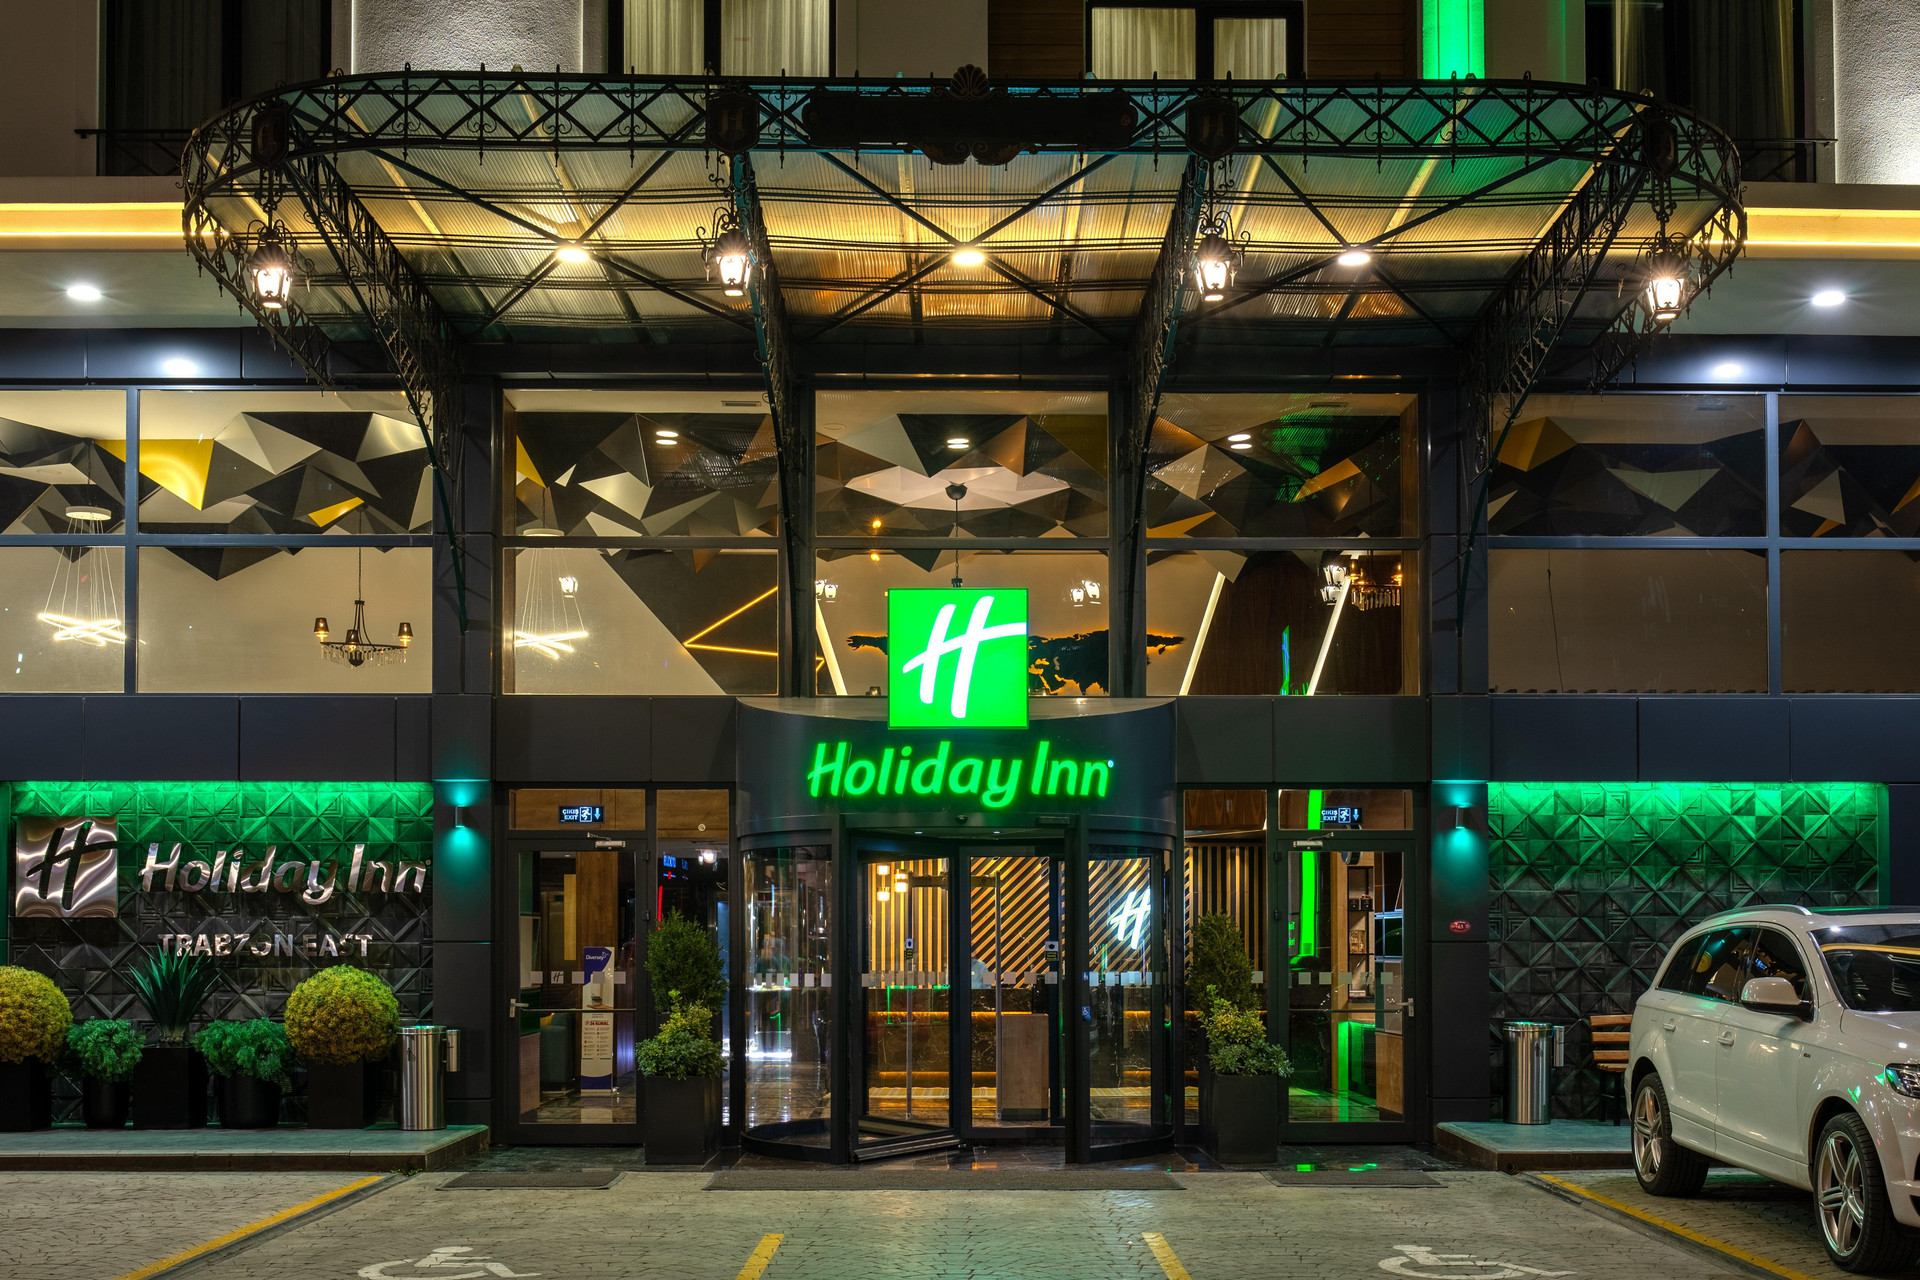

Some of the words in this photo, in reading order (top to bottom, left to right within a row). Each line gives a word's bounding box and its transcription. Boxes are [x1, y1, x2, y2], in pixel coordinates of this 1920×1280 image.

[902, 596, 1026, 719] H
[807, 740, 1023, 809] Holiday
[1031, 740, 1109, 797] Inn
[138, 842, 339, 905] Holiday
[348, 843, 427, 893] Inn
[157, 933, 293, 957] TRABZON
[302, 933, 373, 957] EAST
